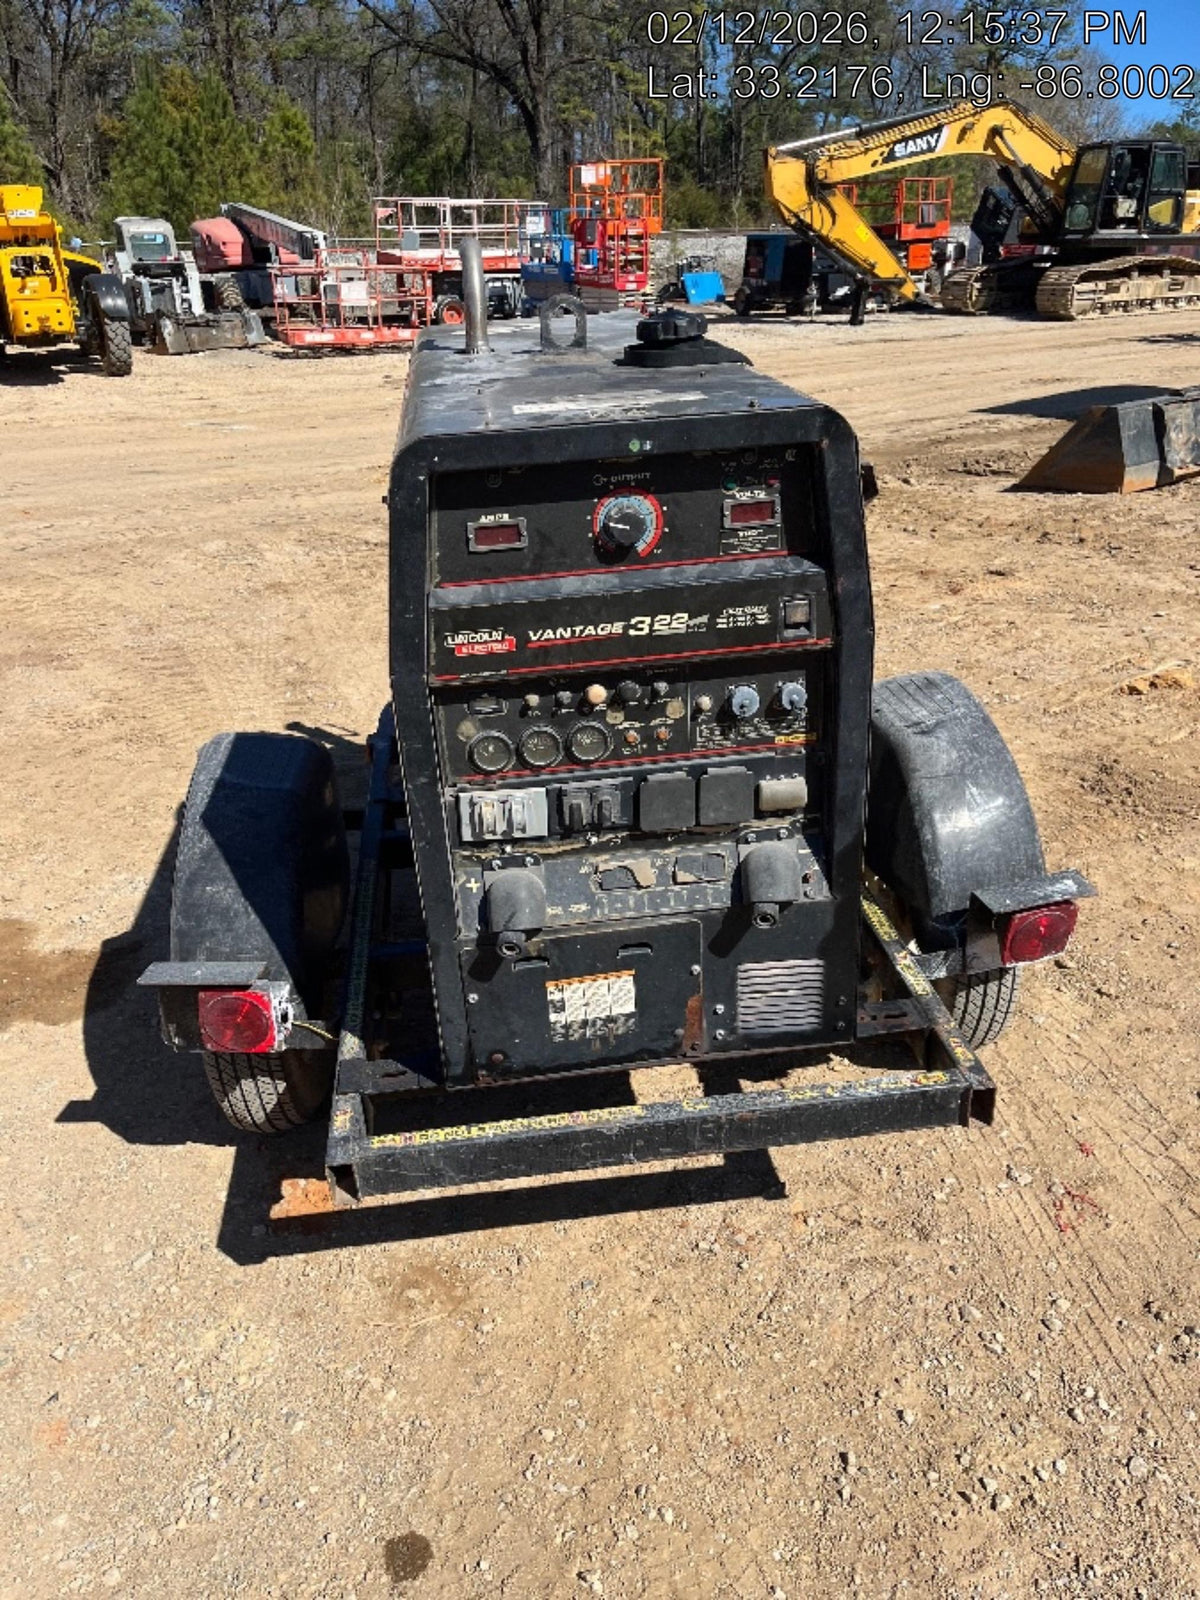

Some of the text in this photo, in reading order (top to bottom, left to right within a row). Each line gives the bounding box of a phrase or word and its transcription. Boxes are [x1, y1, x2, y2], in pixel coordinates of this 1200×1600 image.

[894, 132, 939, 157] SANY
[446, 630, 503, 645] LINCOLN
[528, 622, 626, 641] VANTAGE
[628, 612, 689, 636] 322
